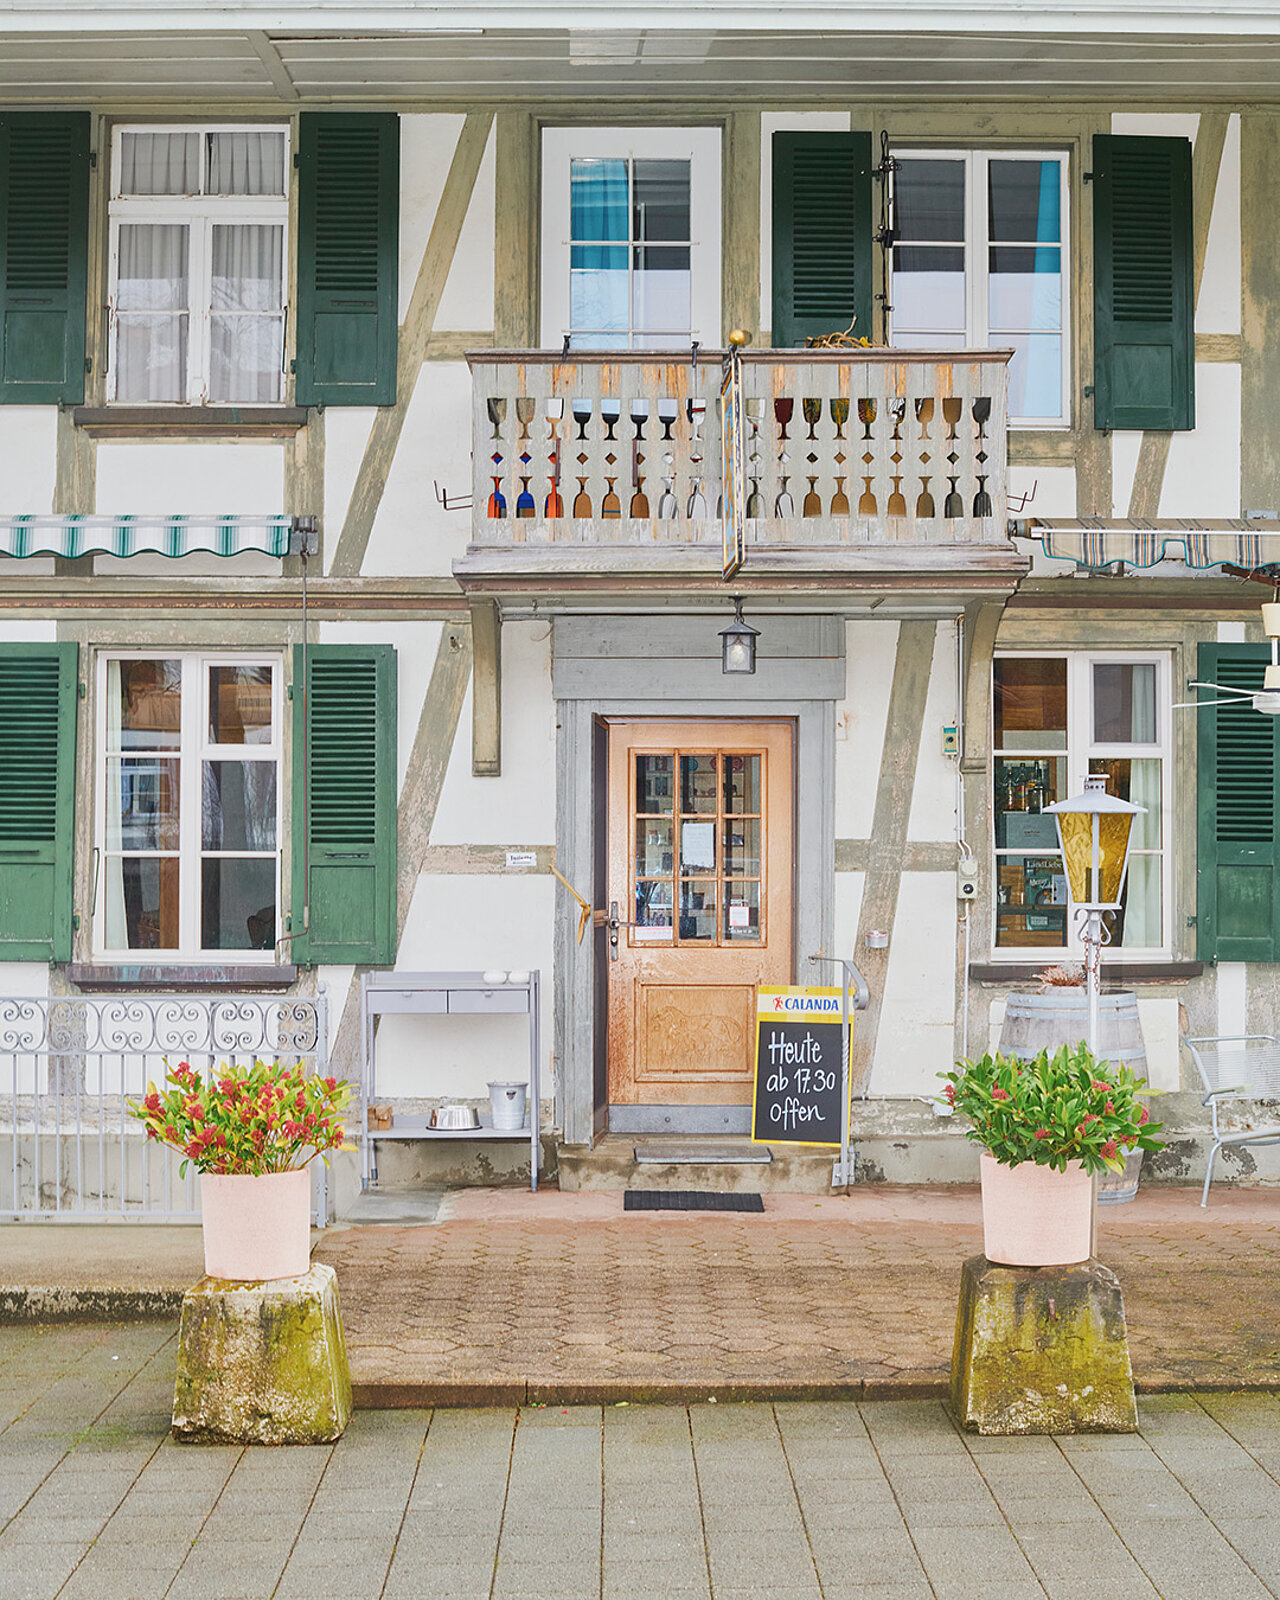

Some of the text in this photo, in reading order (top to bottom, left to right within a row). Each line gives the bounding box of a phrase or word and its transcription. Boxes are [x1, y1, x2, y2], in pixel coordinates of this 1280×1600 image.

[785, 997, 839, 1011] CALANDA
[768, 1031, 823, 1065] Heute
[766, 1066, 836, 1094] ab 17.30
[769, 1096, 826, 1131] offen
